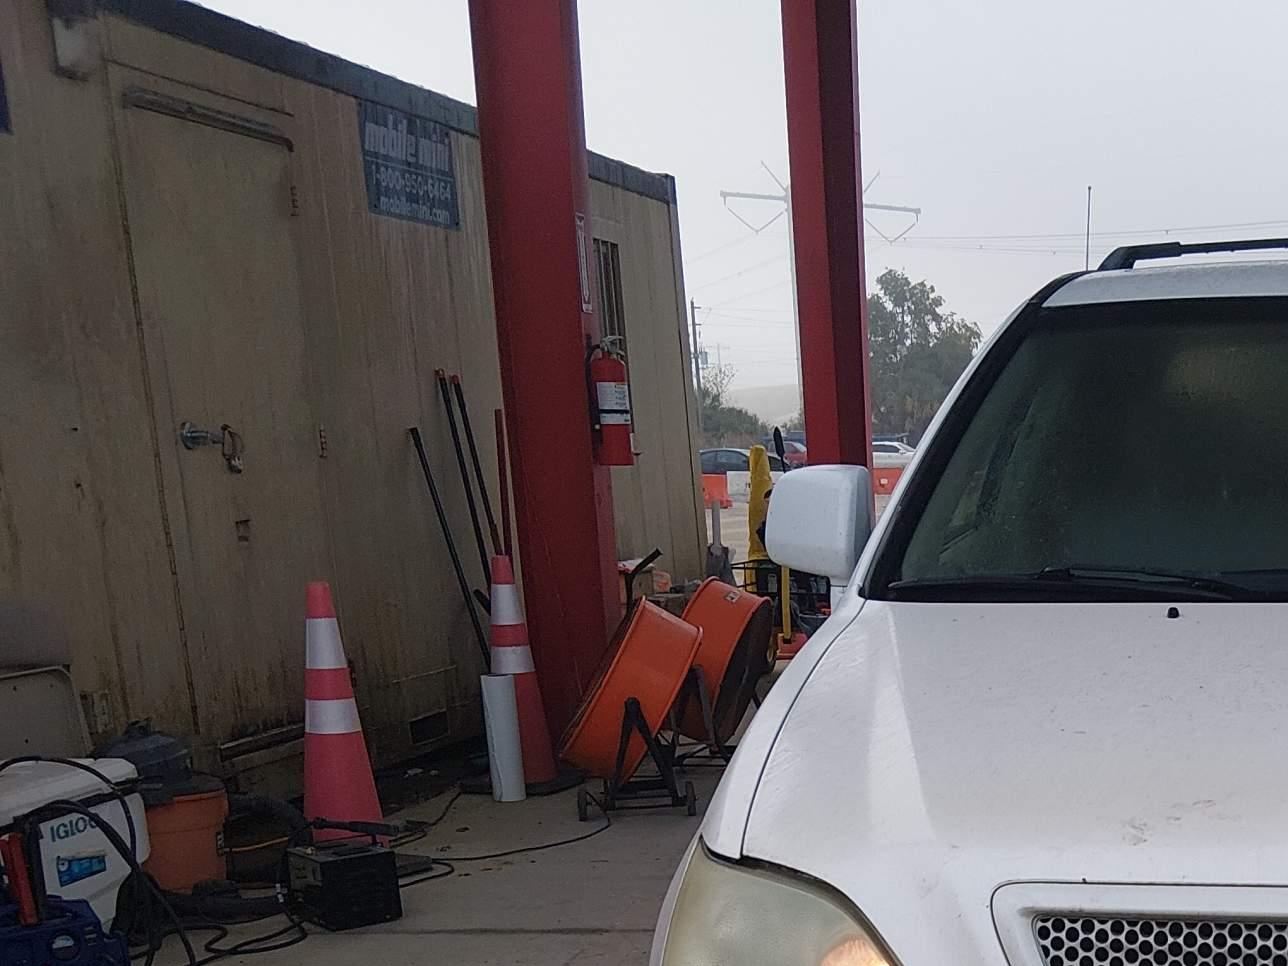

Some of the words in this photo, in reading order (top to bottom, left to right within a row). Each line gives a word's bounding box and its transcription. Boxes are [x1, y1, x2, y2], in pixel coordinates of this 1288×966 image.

[364, 114, 416, 163] mobile
[418, 131, 449, 172] mini
[380, 196, 450, 225] mobilemini.com
